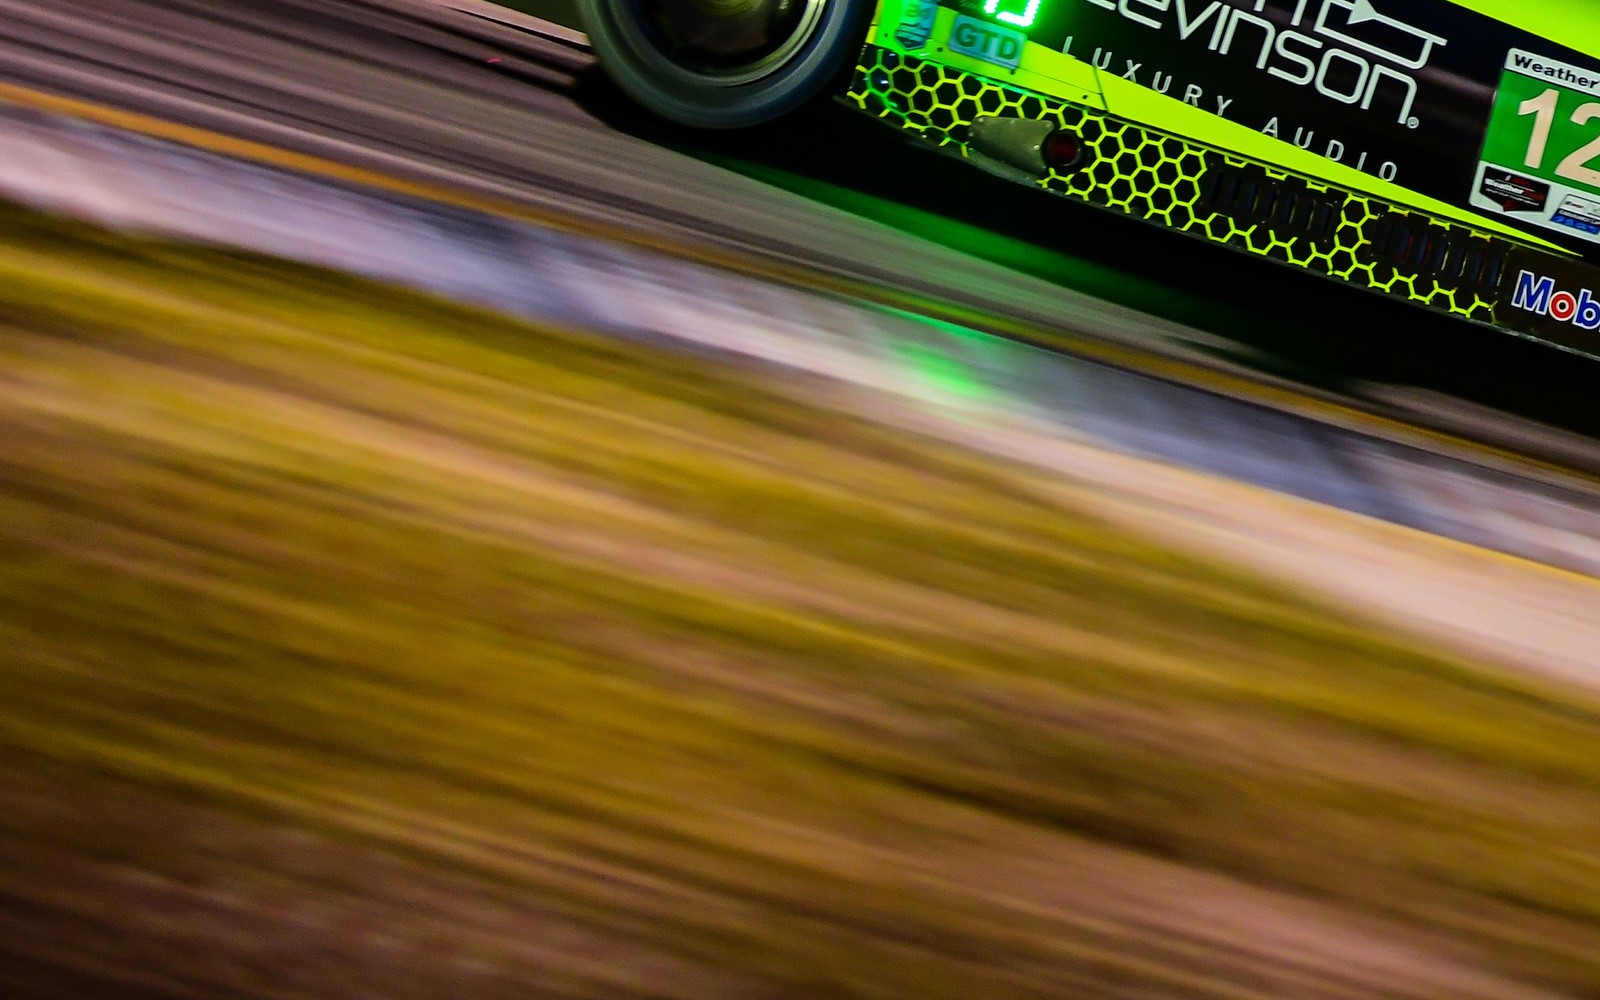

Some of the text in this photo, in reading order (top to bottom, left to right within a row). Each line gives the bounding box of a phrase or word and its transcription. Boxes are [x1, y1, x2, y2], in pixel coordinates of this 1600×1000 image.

[954, 22, 1020, 61] GTD
[1062, 34, 1399, 183] LUXURY AUDIO
